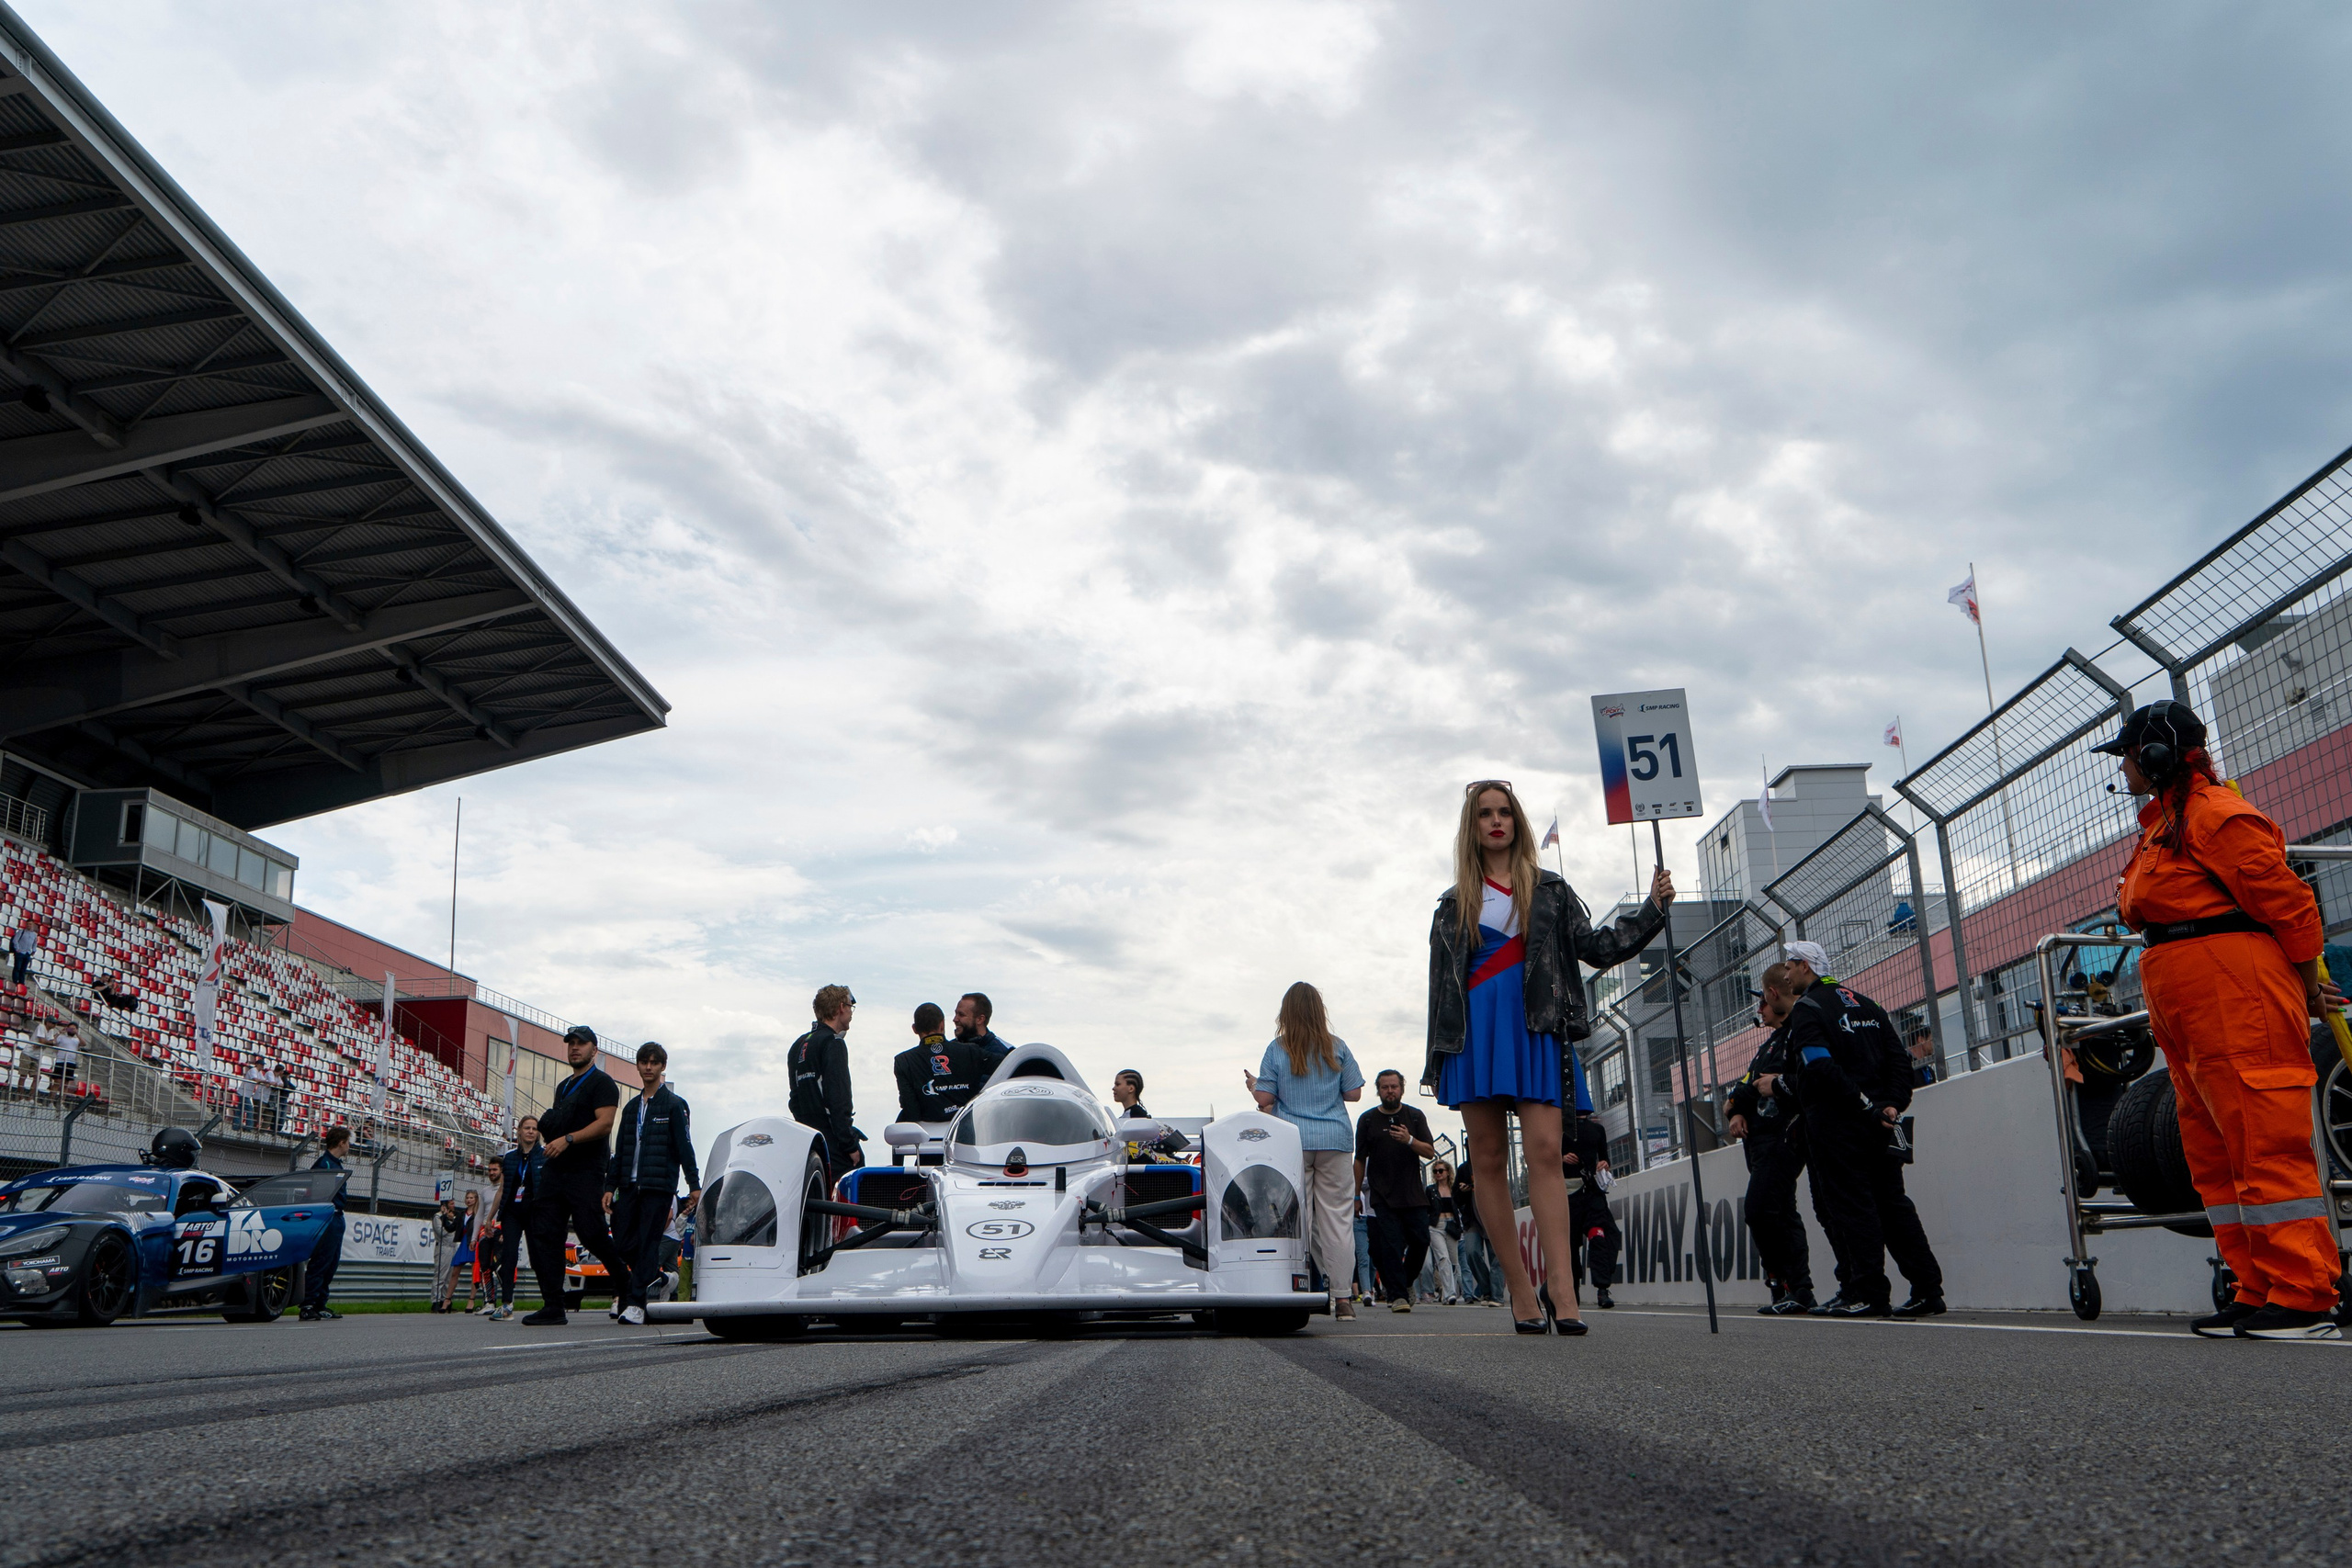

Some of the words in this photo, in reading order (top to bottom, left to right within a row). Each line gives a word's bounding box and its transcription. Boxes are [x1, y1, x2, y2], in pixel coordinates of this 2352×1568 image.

[1627, 732, 1682, 782] 51
[441, 1179, 453, 1192] 37
[353, 1221, 399, 1246] SPACE
[981, 1224, 1021, 1235] 51
[177, 1239, 216, 1264] 16
[376, 1246, 396, 1257] TRAVEL
[22, 1258, 56, 1266] YOKOHAMA
